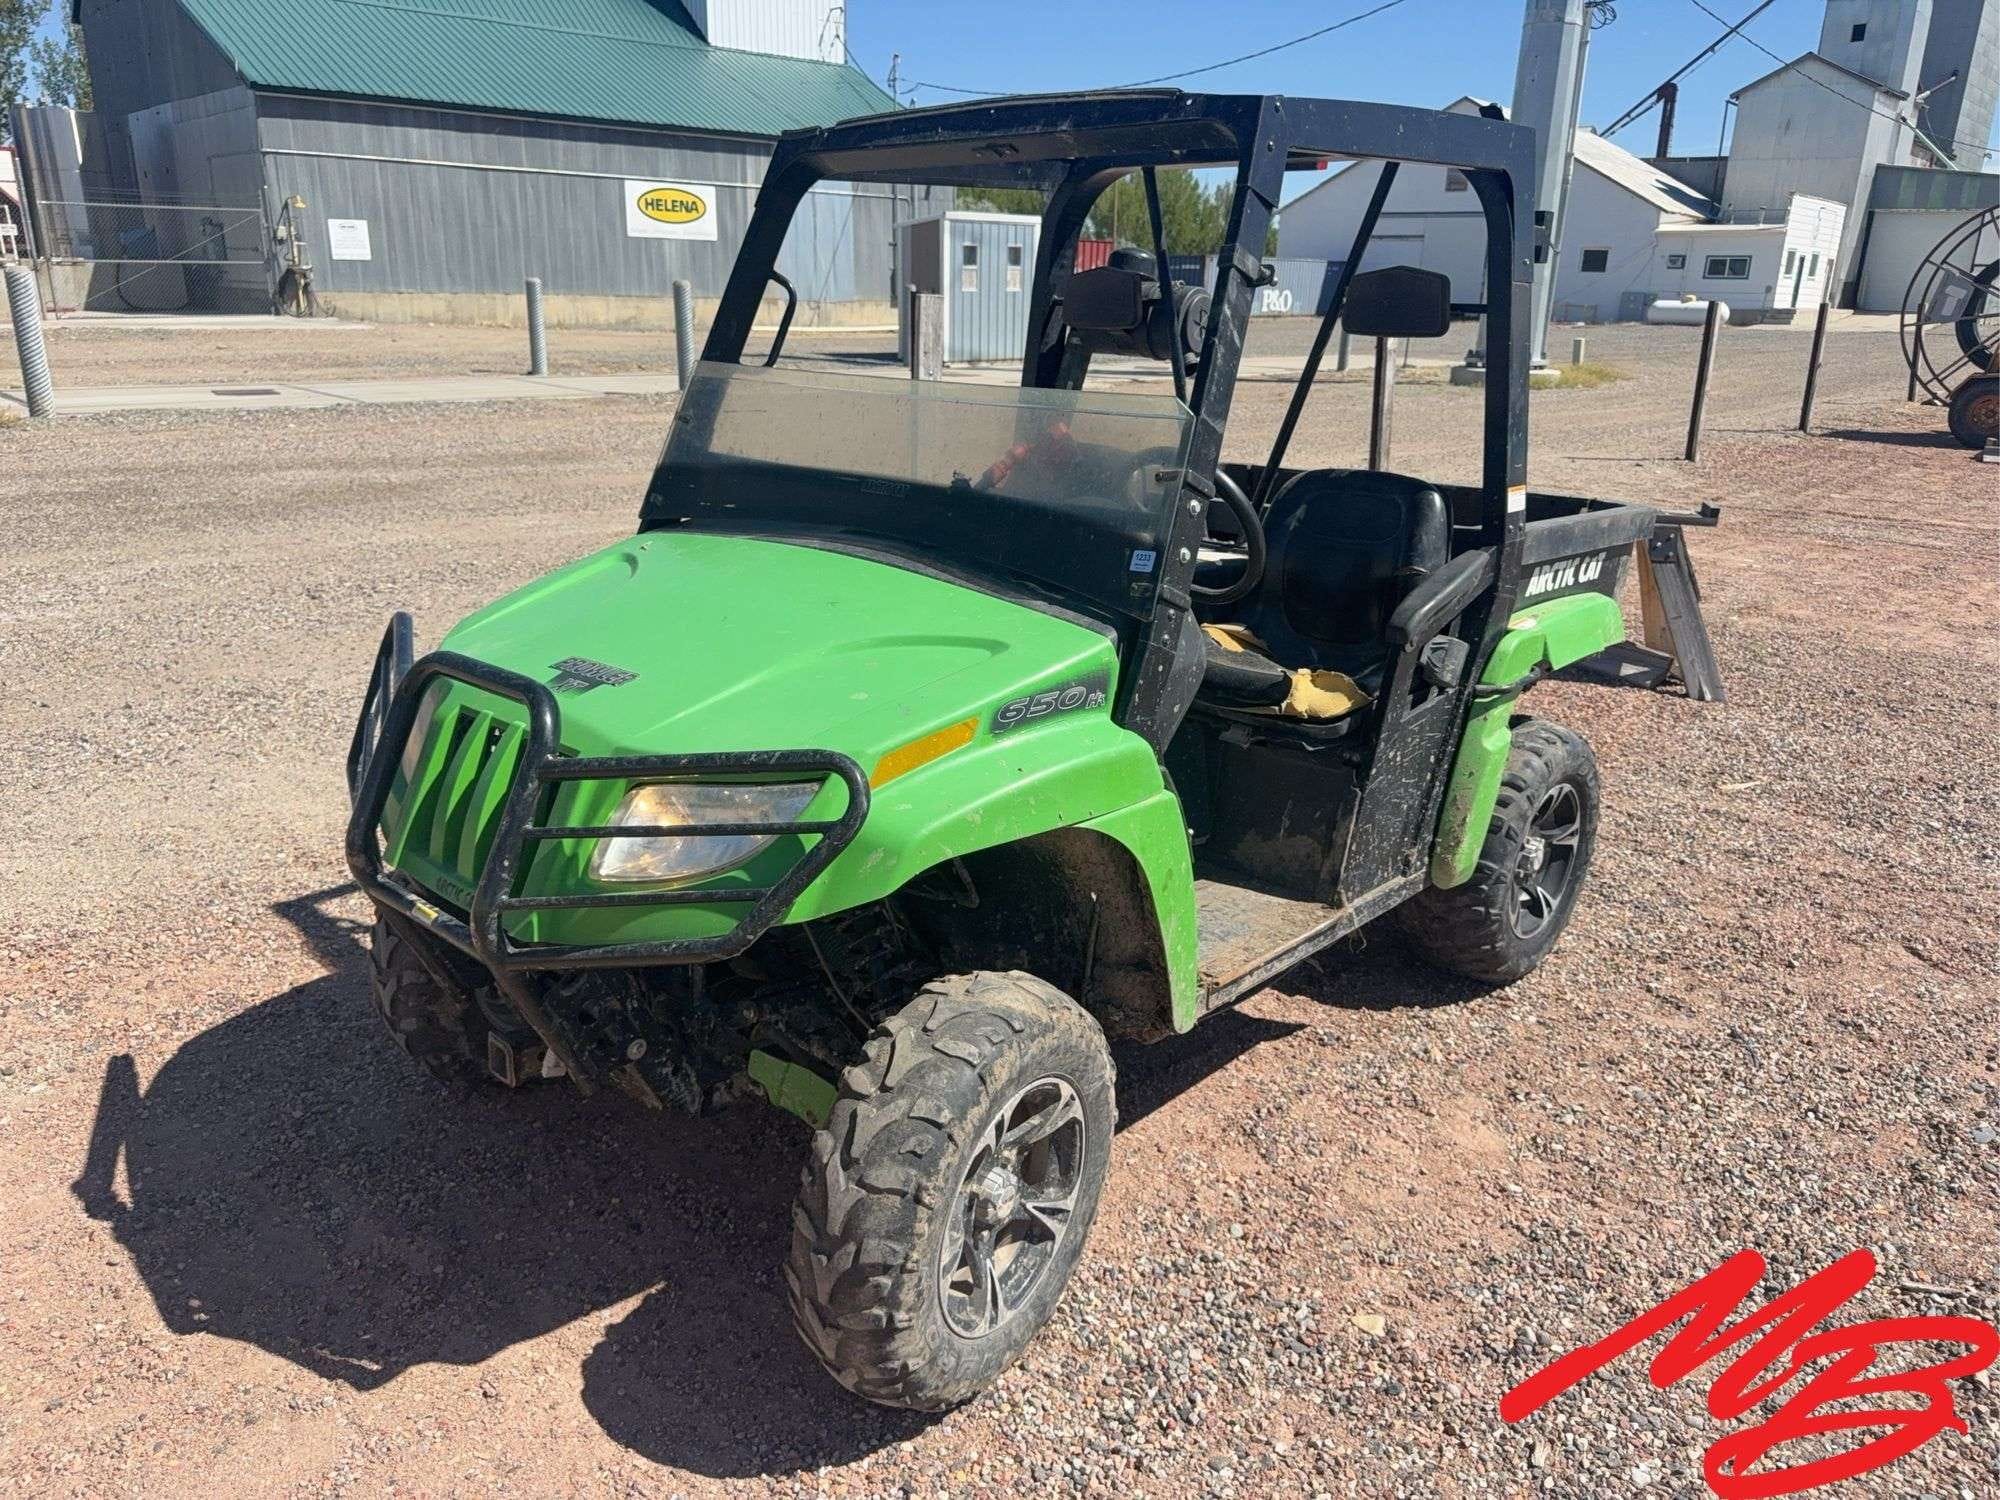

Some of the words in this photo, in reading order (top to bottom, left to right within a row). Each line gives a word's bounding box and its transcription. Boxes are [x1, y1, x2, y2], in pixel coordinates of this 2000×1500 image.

[644, 198, 700, 214] HELENA
[1262, 289, 1293, 312] P&O
[1525, 558, 1581, 597] ARCTIC
[1578, 552, 1607, 583] CAT
[998, 686, 1087, 723] 650
